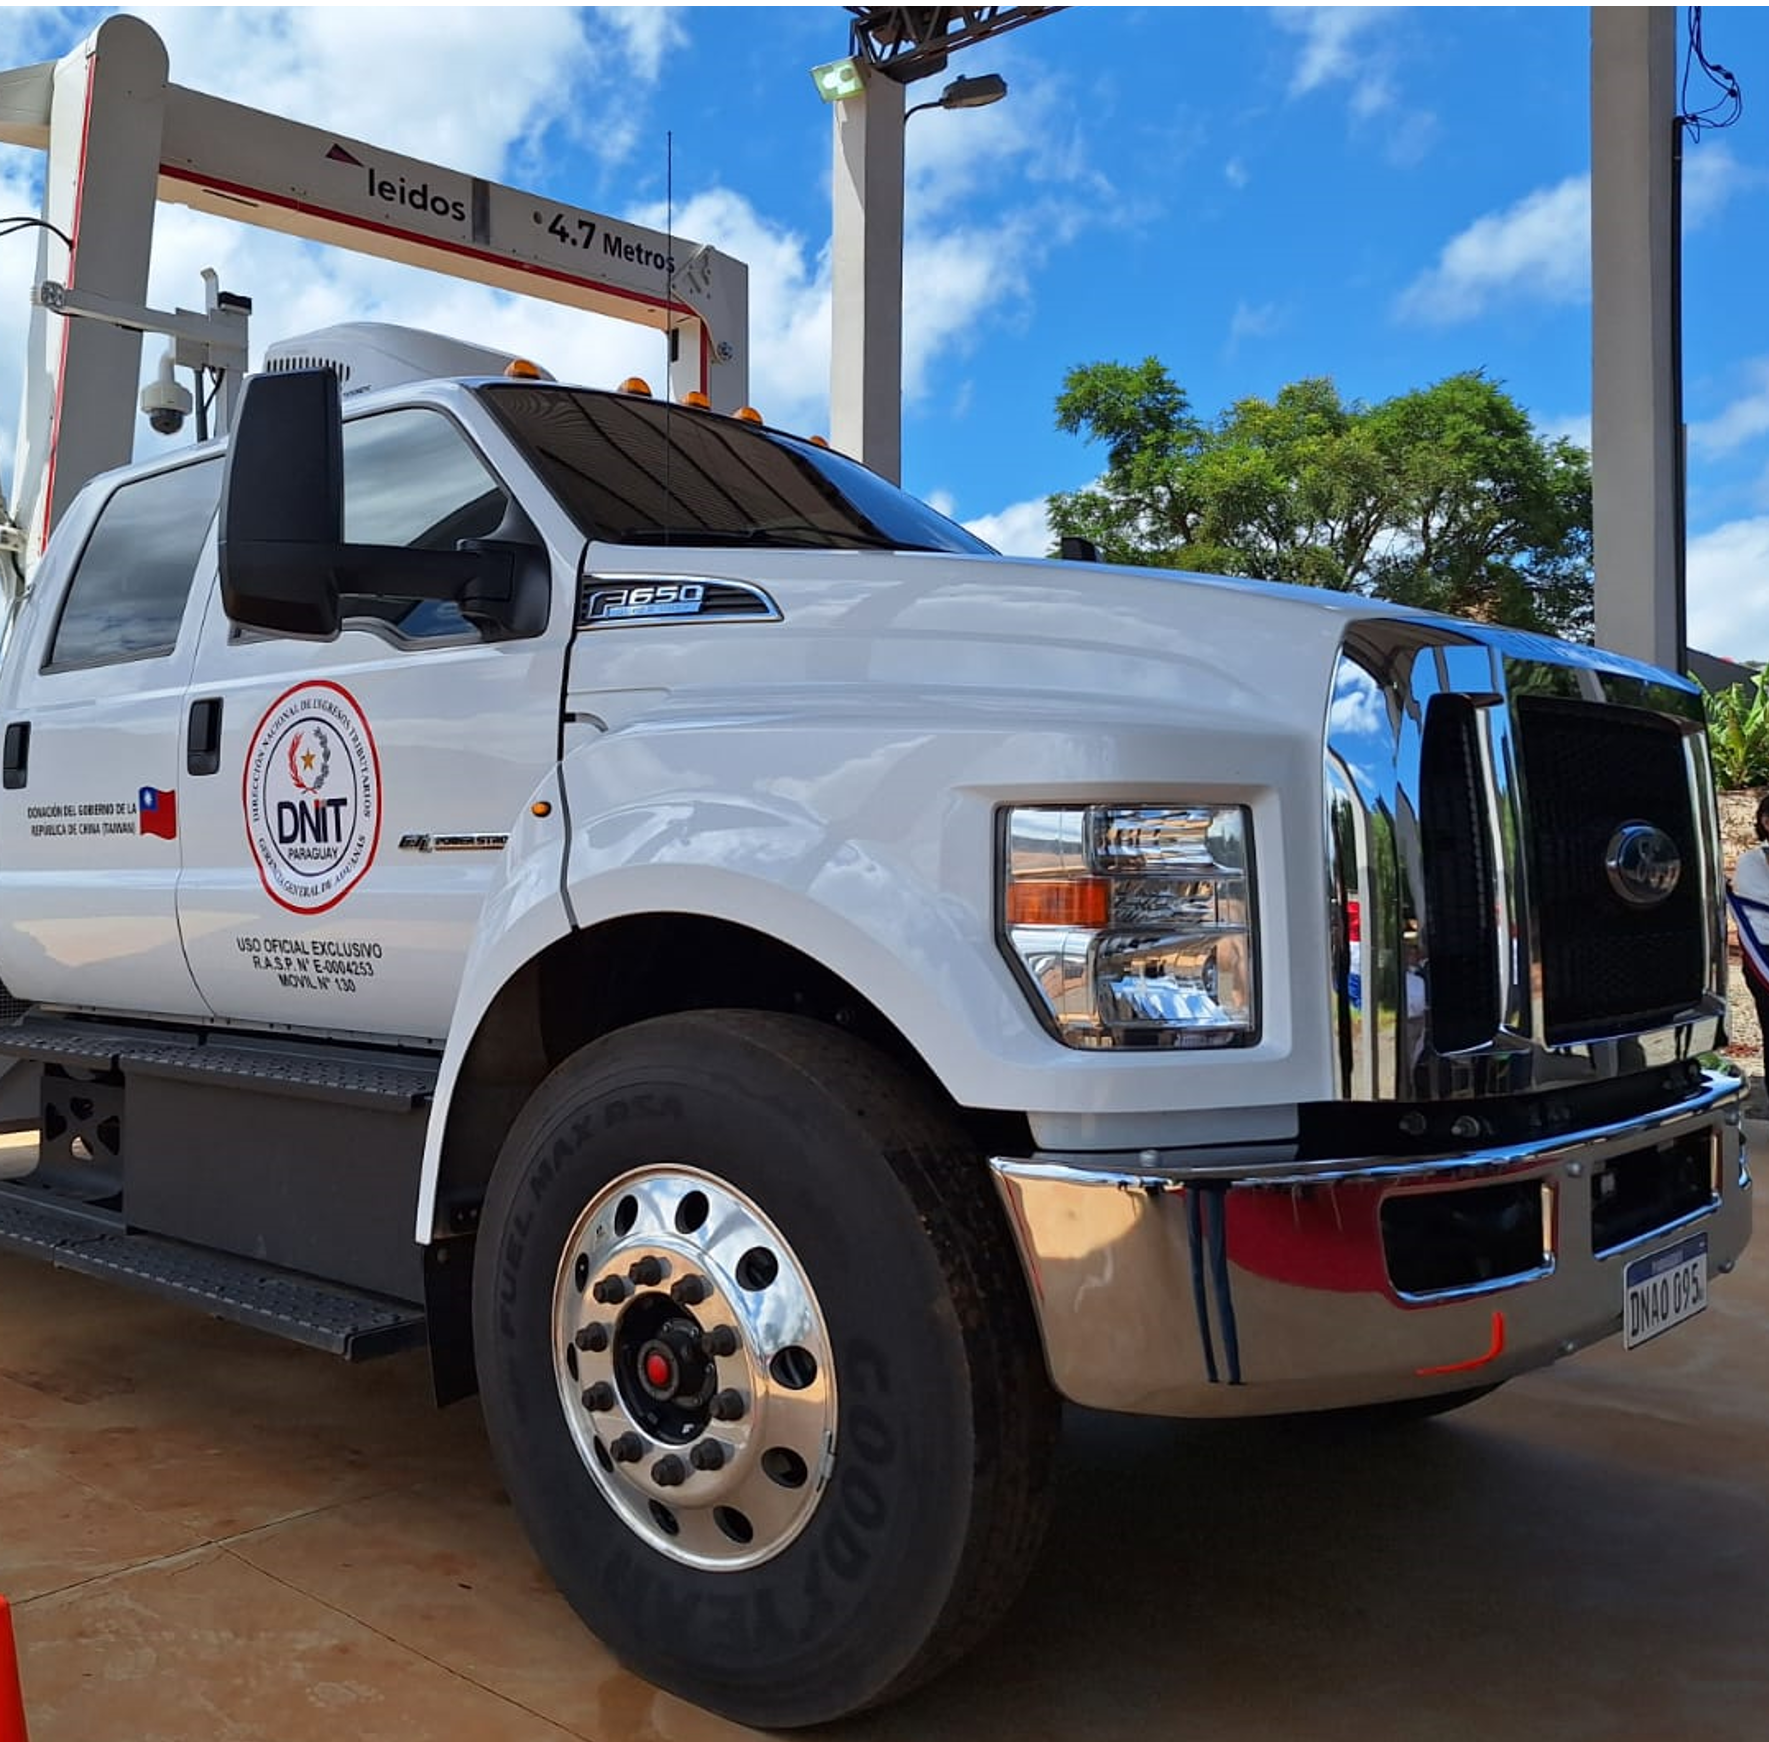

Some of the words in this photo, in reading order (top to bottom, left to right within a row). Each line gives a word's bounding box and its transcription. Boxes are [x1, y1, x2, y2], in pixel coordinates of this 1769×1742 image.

[366, 168, 466, 222] leidos
[547, 212, 596, 250] 4.7
[601, 232, 676, 274] Metros
[63, 804, 77, 818] DEL
[78, 803, 114, 817] GOBIERNO
[115, 802, 126, 815] DE
[127, 802, 137, 815] LA
[277, 798, 348, 844] DNIT
[68, 823, 78, 836] DE
[79, 822, 100, 835] CHINA
[287, 847, 339, 861] PARAGUAY
[236, 937, 262, 953] USO
[263, 938, 310, 956] OFICIAL
[311, 940, 383, 959] EXCLUSIVO
[313, 959, 374, 977] E-0004253
[333, 977, 357, 993] 130
[530, 1114, 595, 1203] MAX
[1672, 1262, 1699, 1314] 095
